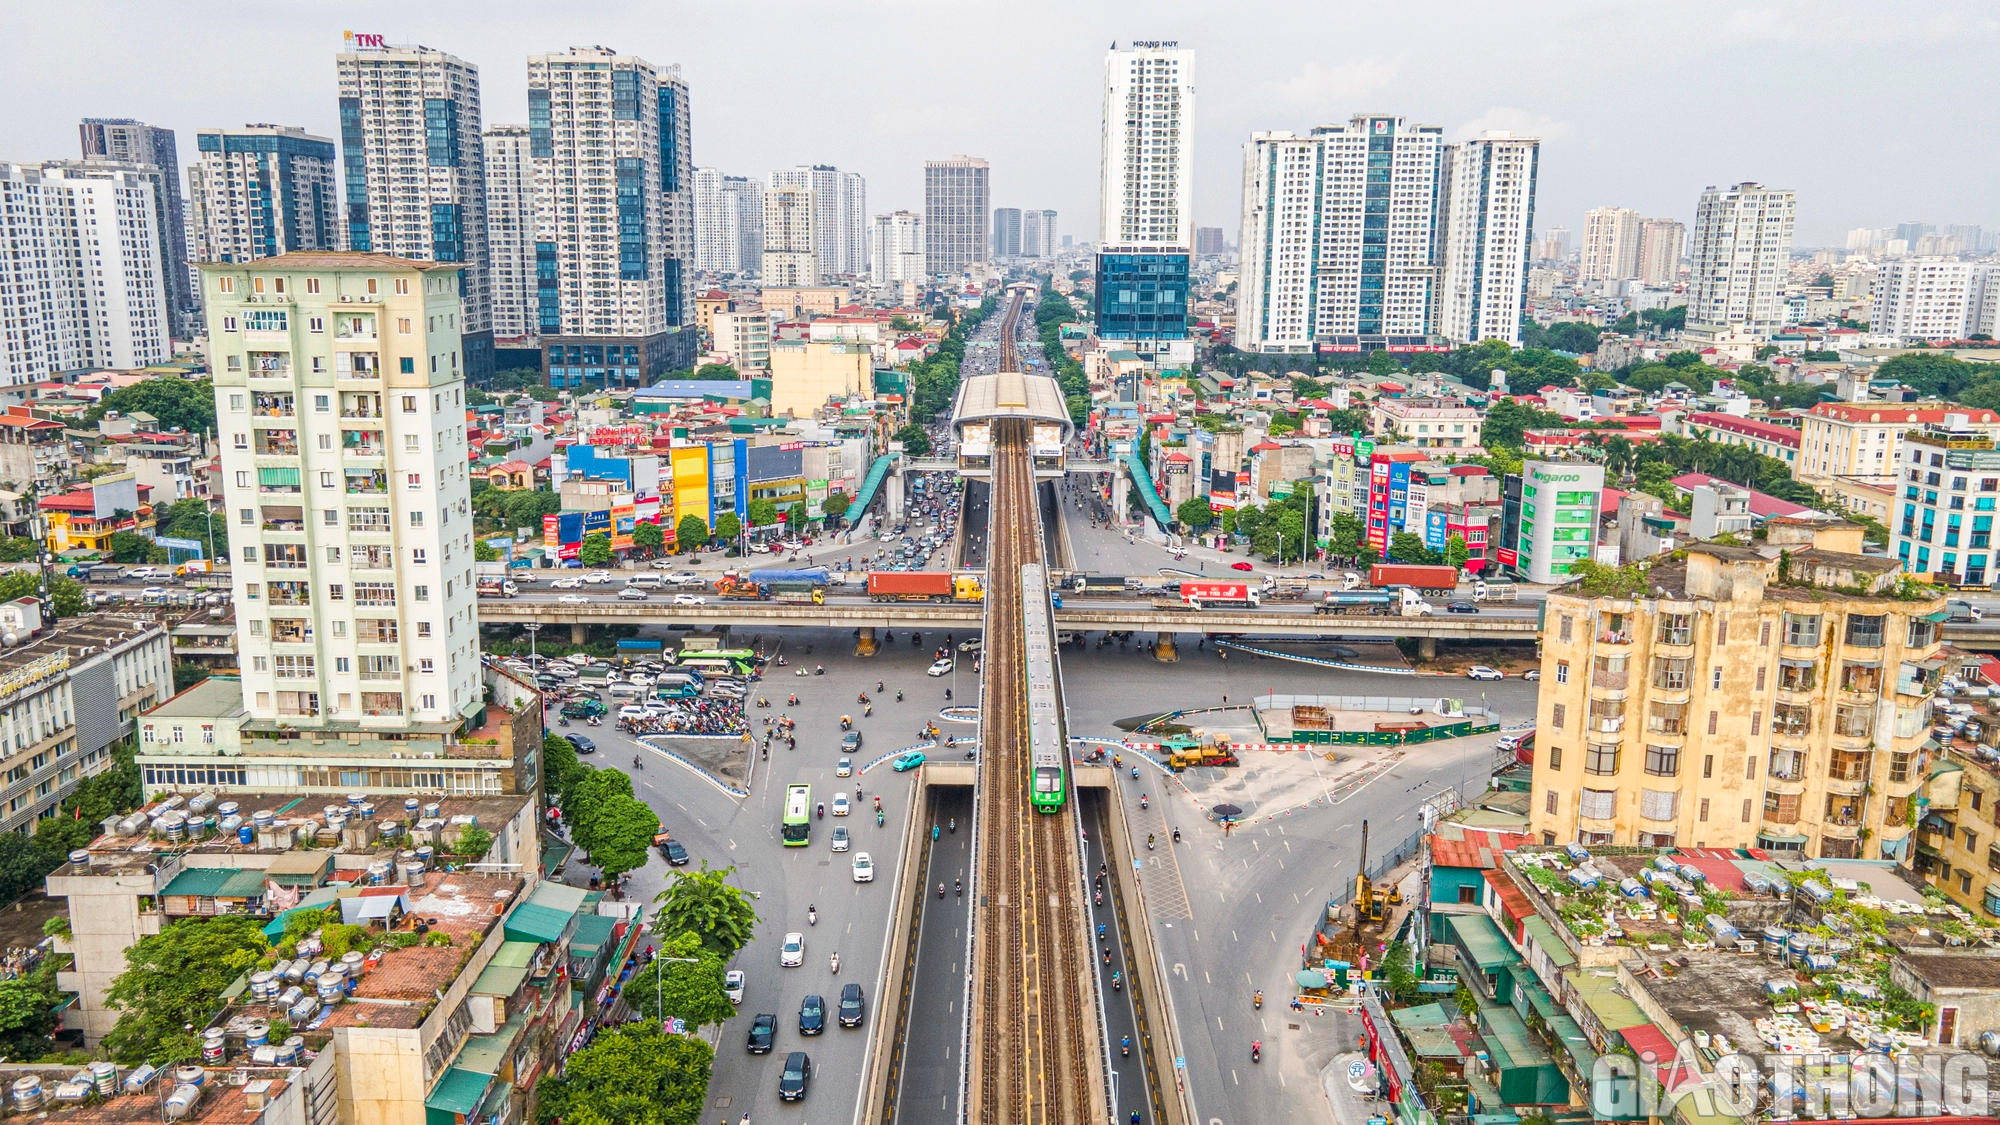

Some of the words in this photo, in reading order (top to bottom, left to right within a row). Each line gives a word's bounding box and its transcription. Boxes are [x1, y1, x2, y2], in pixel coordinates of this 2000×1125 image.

[355, 33, 384, 47] TNR
[1162, 40, 1178, 48] HUY
[1529, 466, 1581, 484] Kangaroo
